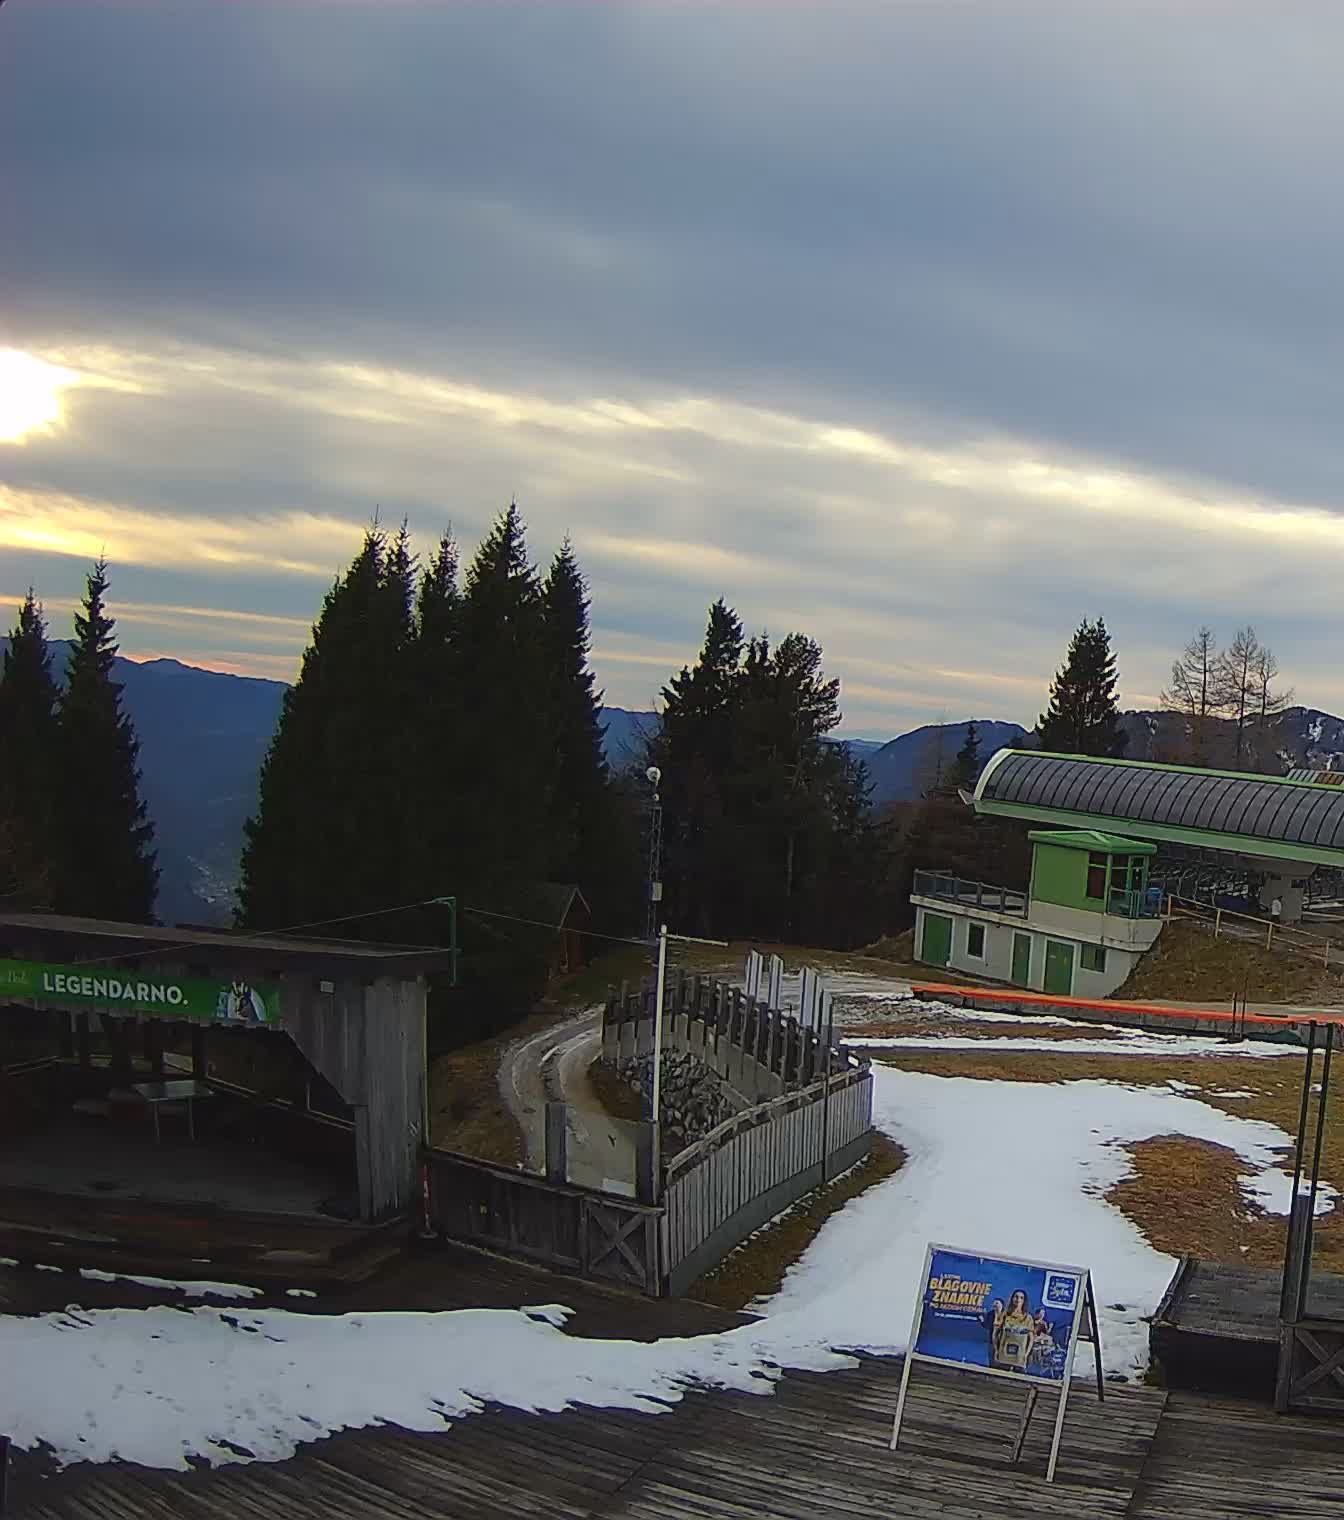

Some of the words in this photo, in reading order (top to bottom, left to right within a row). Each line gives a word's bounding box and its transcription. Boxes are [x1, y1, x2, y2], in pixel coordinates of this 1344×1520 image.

[43, 972, 189, 1006] LEGENDARNO.
[929, 1277, 993, 1295] BLAGOVNE
[932, 1290, 985, 1306] ZNAMKE
